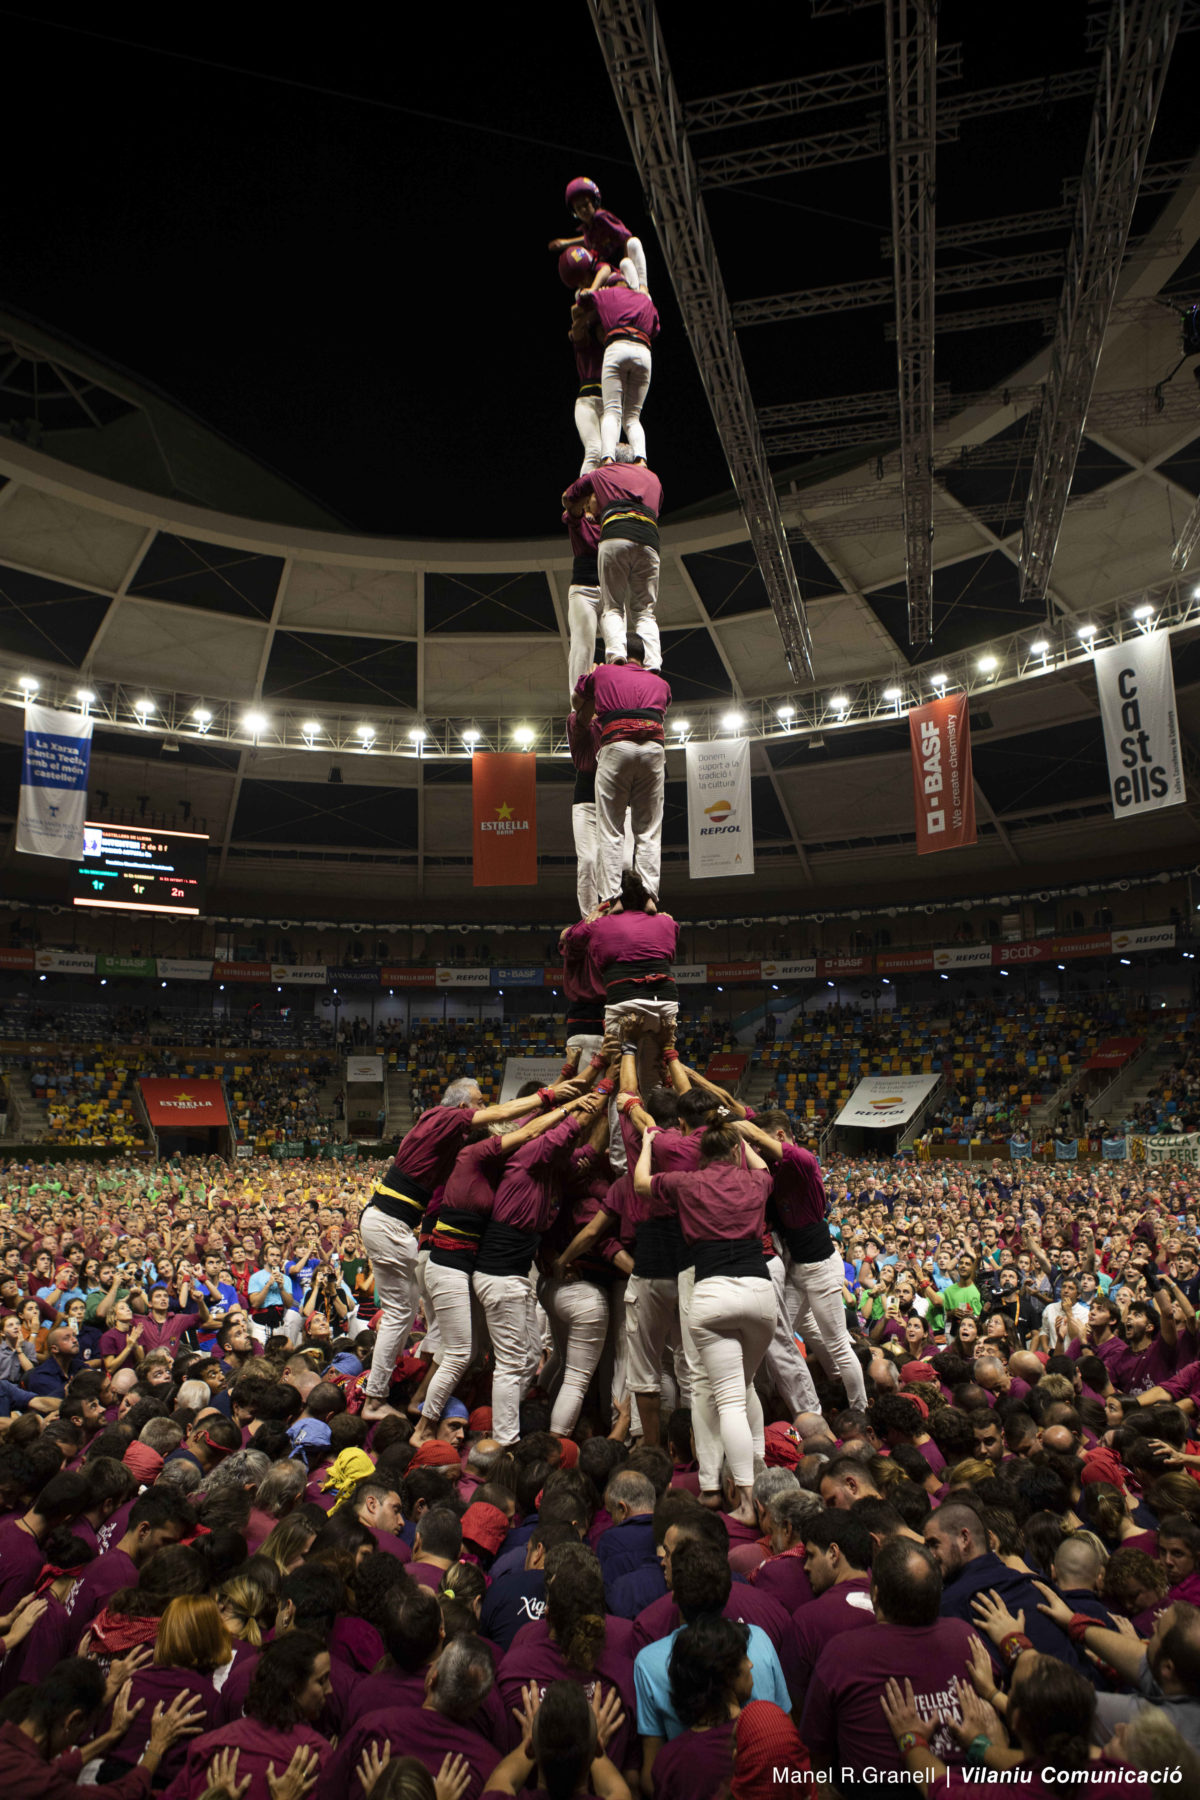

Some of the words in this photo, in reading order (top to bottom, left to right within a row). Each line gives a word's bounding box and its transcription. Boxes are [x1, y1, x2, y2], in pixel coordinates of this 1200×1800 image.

[947, 714, 958, 769] chemistry
[36, 739, 48, 750] La
[50, 741, 79, 756] Xarxa
[26, 747, 56, 760] Santa
[698, 753, 726, 762] Donem
[921, 720, 944, 794] BASF
[25, 758, 48, 769] amb
[49, 761, 60, 771] el
[699, 761, 723, 772] suport
[34, 768, 77, 783] casteller
[698, 770, 727, 780] tradició
[708, 780, 735, 789] cultura
[951, 771, 961, 806] create
[953, 809, 962, 829] We
[481, 820, 529, 830] ESTRELLA
[700, 825, 742, 835] REPSOL
[147, 843, 157, 851] de
[92, 880, 104, 890] 1r
[133, 883, 145, 894] 1r
[171, 887, 184, 897] 2n
[1136, 933, 1173, 944] REPSOL
[839, 958, 863, 967] BASF
[955, 953, 991, 962] REPSOL
[57, 959, 94, 968] REPSOL
[119, 959, 147, 968] BASF
[292, 971, 325, 979] REPSOL
[512, 970, 536, 978] BASF
[782, 966, 814, 974] REPSOL
[1150, 1136, 1191, 1147] COLLA
[1169, 1148, 1198, 1161] PERE
[914, 1691, 959, 1711] TELLERS
